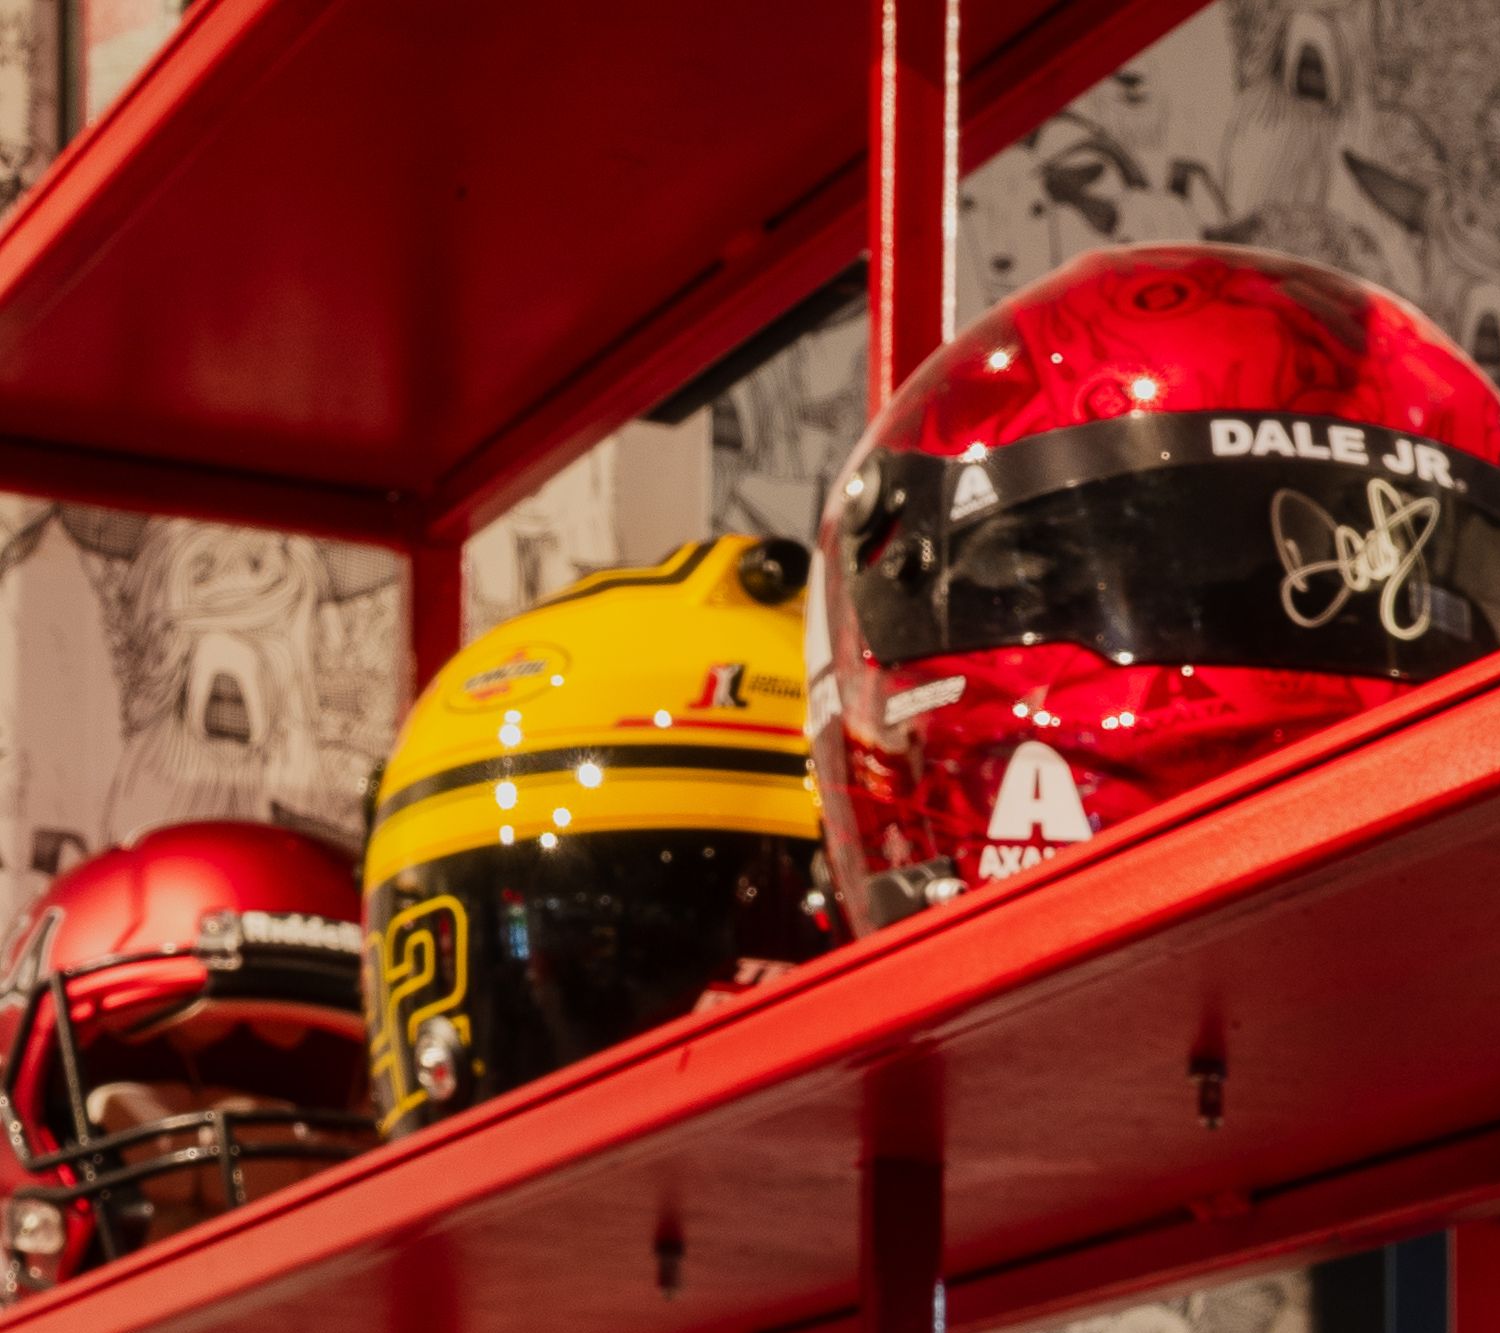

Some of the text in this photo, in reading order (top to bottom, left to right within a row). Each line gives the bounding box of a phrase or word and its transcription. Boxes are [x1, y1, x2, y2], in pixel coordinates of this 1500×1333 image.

[1210, 418, 1468, 493] DALE JR.
[987, 740, 1093, 841] A
